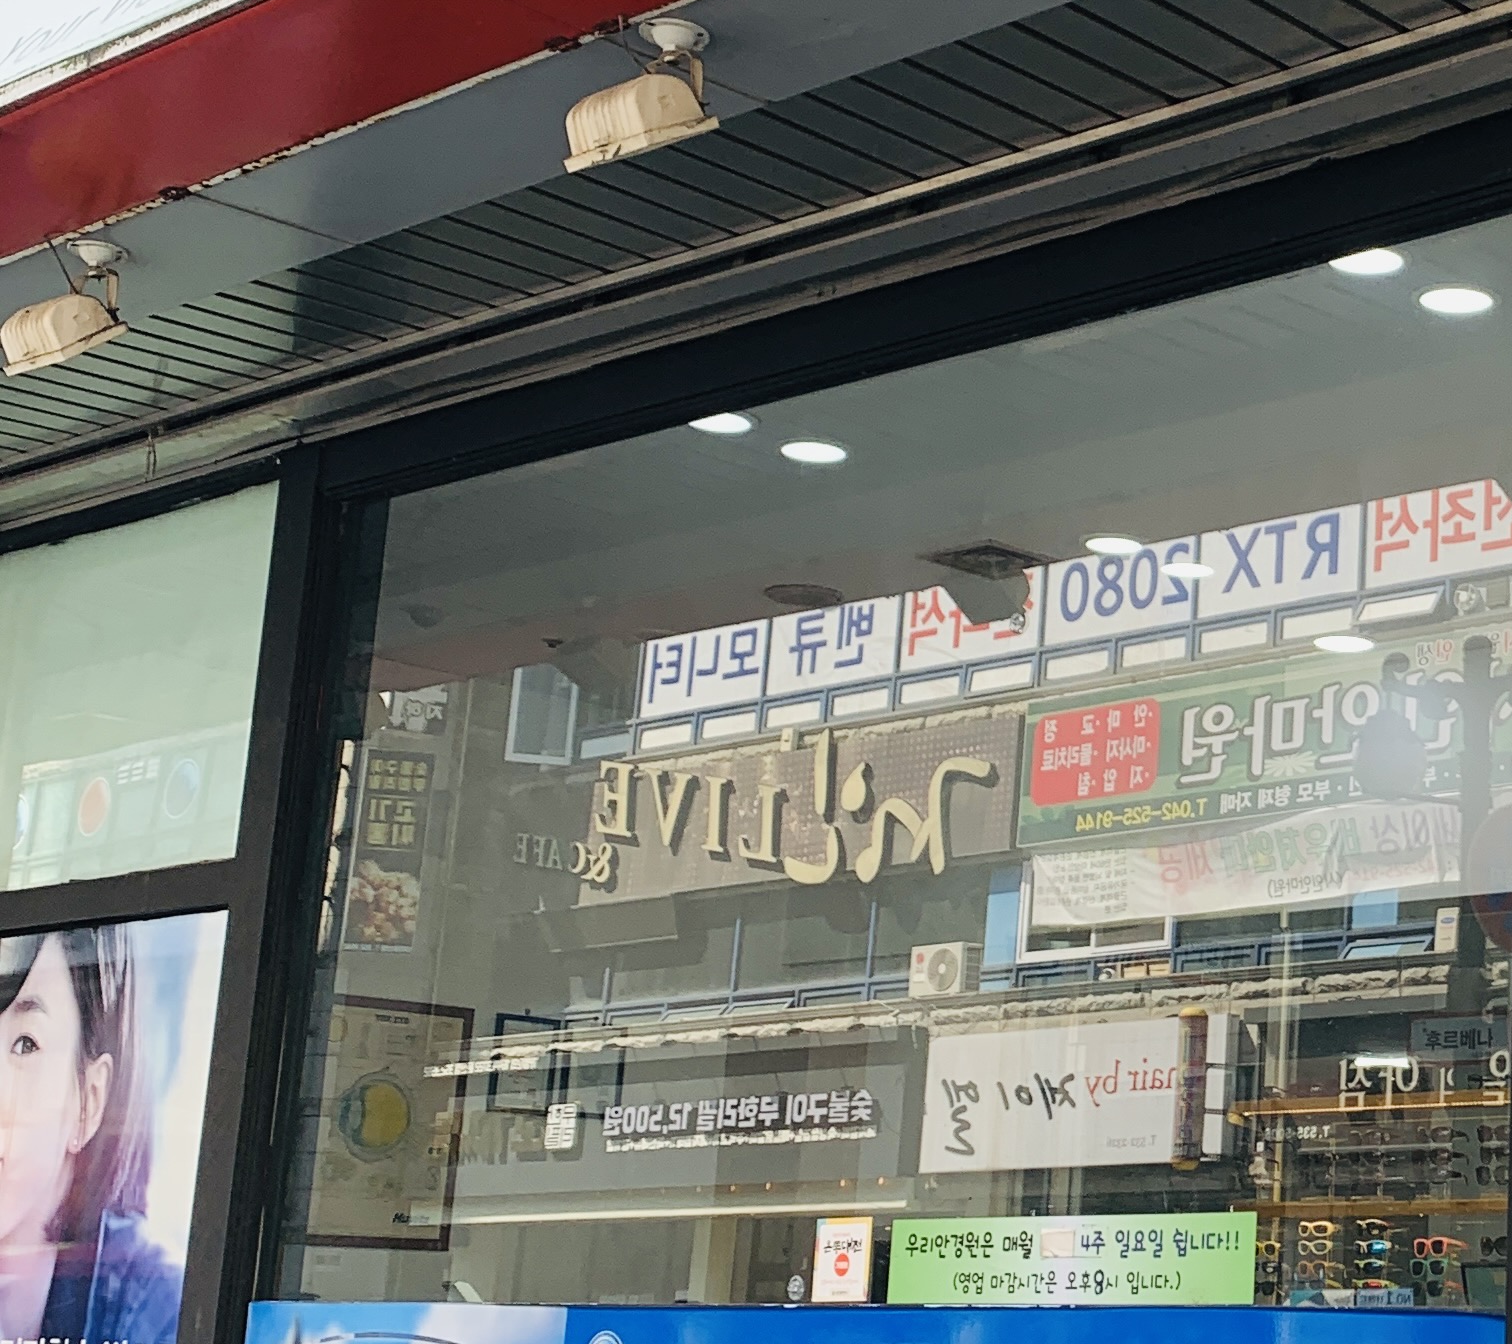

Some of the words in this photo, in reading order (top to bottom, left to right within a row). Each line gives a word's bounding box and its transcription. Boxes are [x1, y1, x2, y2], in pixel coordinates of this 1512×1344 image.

[906, 1232, 994, 1258] 우리안경원은
[1003, 1232, 1034, 1258] 매월
[1081, 1230, 1106, 1255] 4주
[1114, 1229, 1164, 1258] 일요일
[1172, 1228, 1240, 1257] 쉽니다!!
[952, 1271, 984, 1295] (영업
[990, 1268, 1057, 1295] 마감시간은
[1126, 1270, 1181, 1295] 입니다.)
